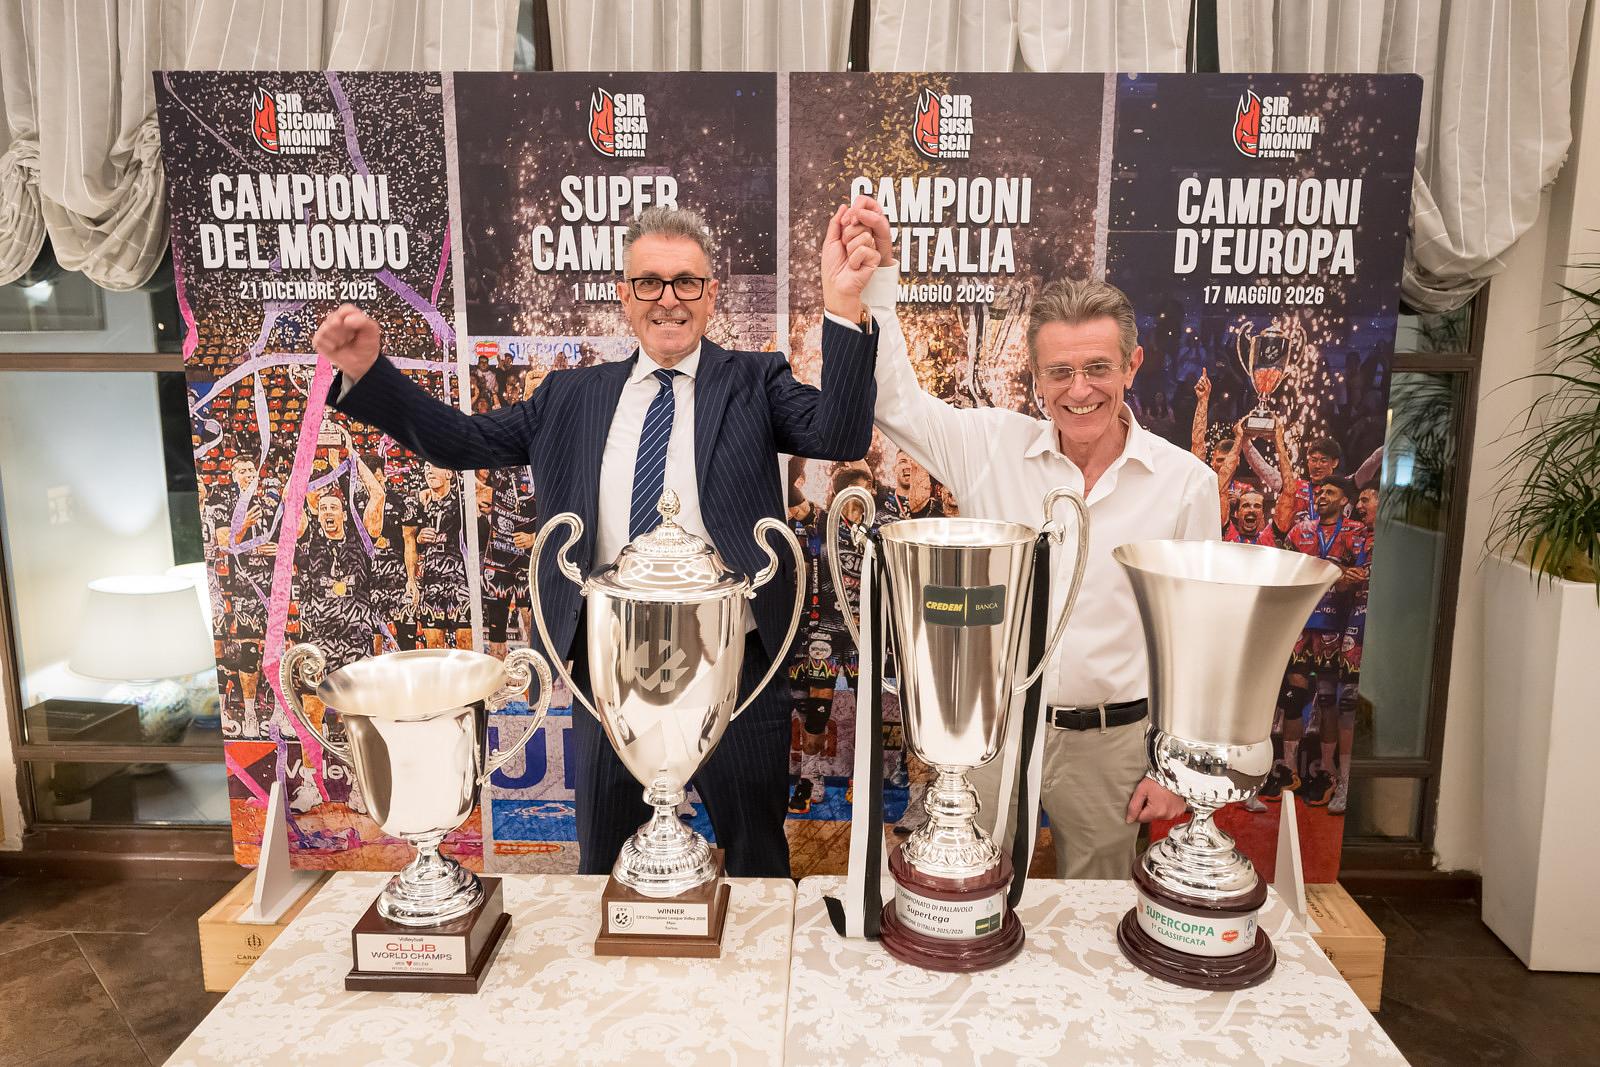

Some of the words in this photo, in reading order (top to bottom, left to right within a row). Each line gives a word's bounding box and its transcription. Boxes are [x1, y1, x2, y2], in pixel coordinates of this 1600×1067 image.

[276, 93, 303, 113] SIR
[614, 93, 646, 117] SIR
[939, 94, 973, 118] SIR
[1262, 96, 1290, 116] SIR
[277, 112, 336, 130] SICOMA
[614, 117, 649, 133] SUSA
[939, 118, 974, 135] SUSA
[1260, 116, 1320, 133] SICOMA
[279, 129, 331, 146] MONINI
[614, 133, 647, 150] SCAI
[938, 134, 972, 151] SCAI
[1258, 133, 1313, 150] MONINI
[280, 146, 316, 155] PERUGIA
[938, 151, 969, 159] PERUGIA
[1258, 150, 1296, 158] PERUGIA
[210, 173, 390, 220] CAMPIONI
[560, 175, 678, 222] SUPER
[1177, 177, 1363, 225] CAMPIONI
[199, 223, 270, 269] DEL
[278, 223, 409, 270] MONDO
[891, 227, 1016, 273] 'ITALIA
[1174, 228, 1355, 275] D'EUROPA
[240, 281, 258, 300] 21
[262, 281, 338, 300] DICEMBRE
[339, 281, 378, 300] 2025
[572, 283, 580, 301] 1
[896, 284, 952, 303] MAGGIO
[956, 284, 995, 303] 2026
[1203, 285, 1221, 304] 17
[1224, 285, 1281, 305] MAGGIO
[1285, 285, 1325, 305] 2026
[926, 601, 963, 612] CREDEM
[975, 602, 998, 611] BANCA
[286, 759, 353, 786] Voley
[906, 904, 950, 923] SuperLega
[939, 905, 973, 913] PALLAVOLO
[1146, 905, 1215, 936] SUPERCOPPA
[1157, 926, 1206, 946] CLASSIFICATA
[371, 952, 408, 960] WORLD
[410, 952, 453, 961] CHAMPS
[386, 943, 436, 952] CLUB
